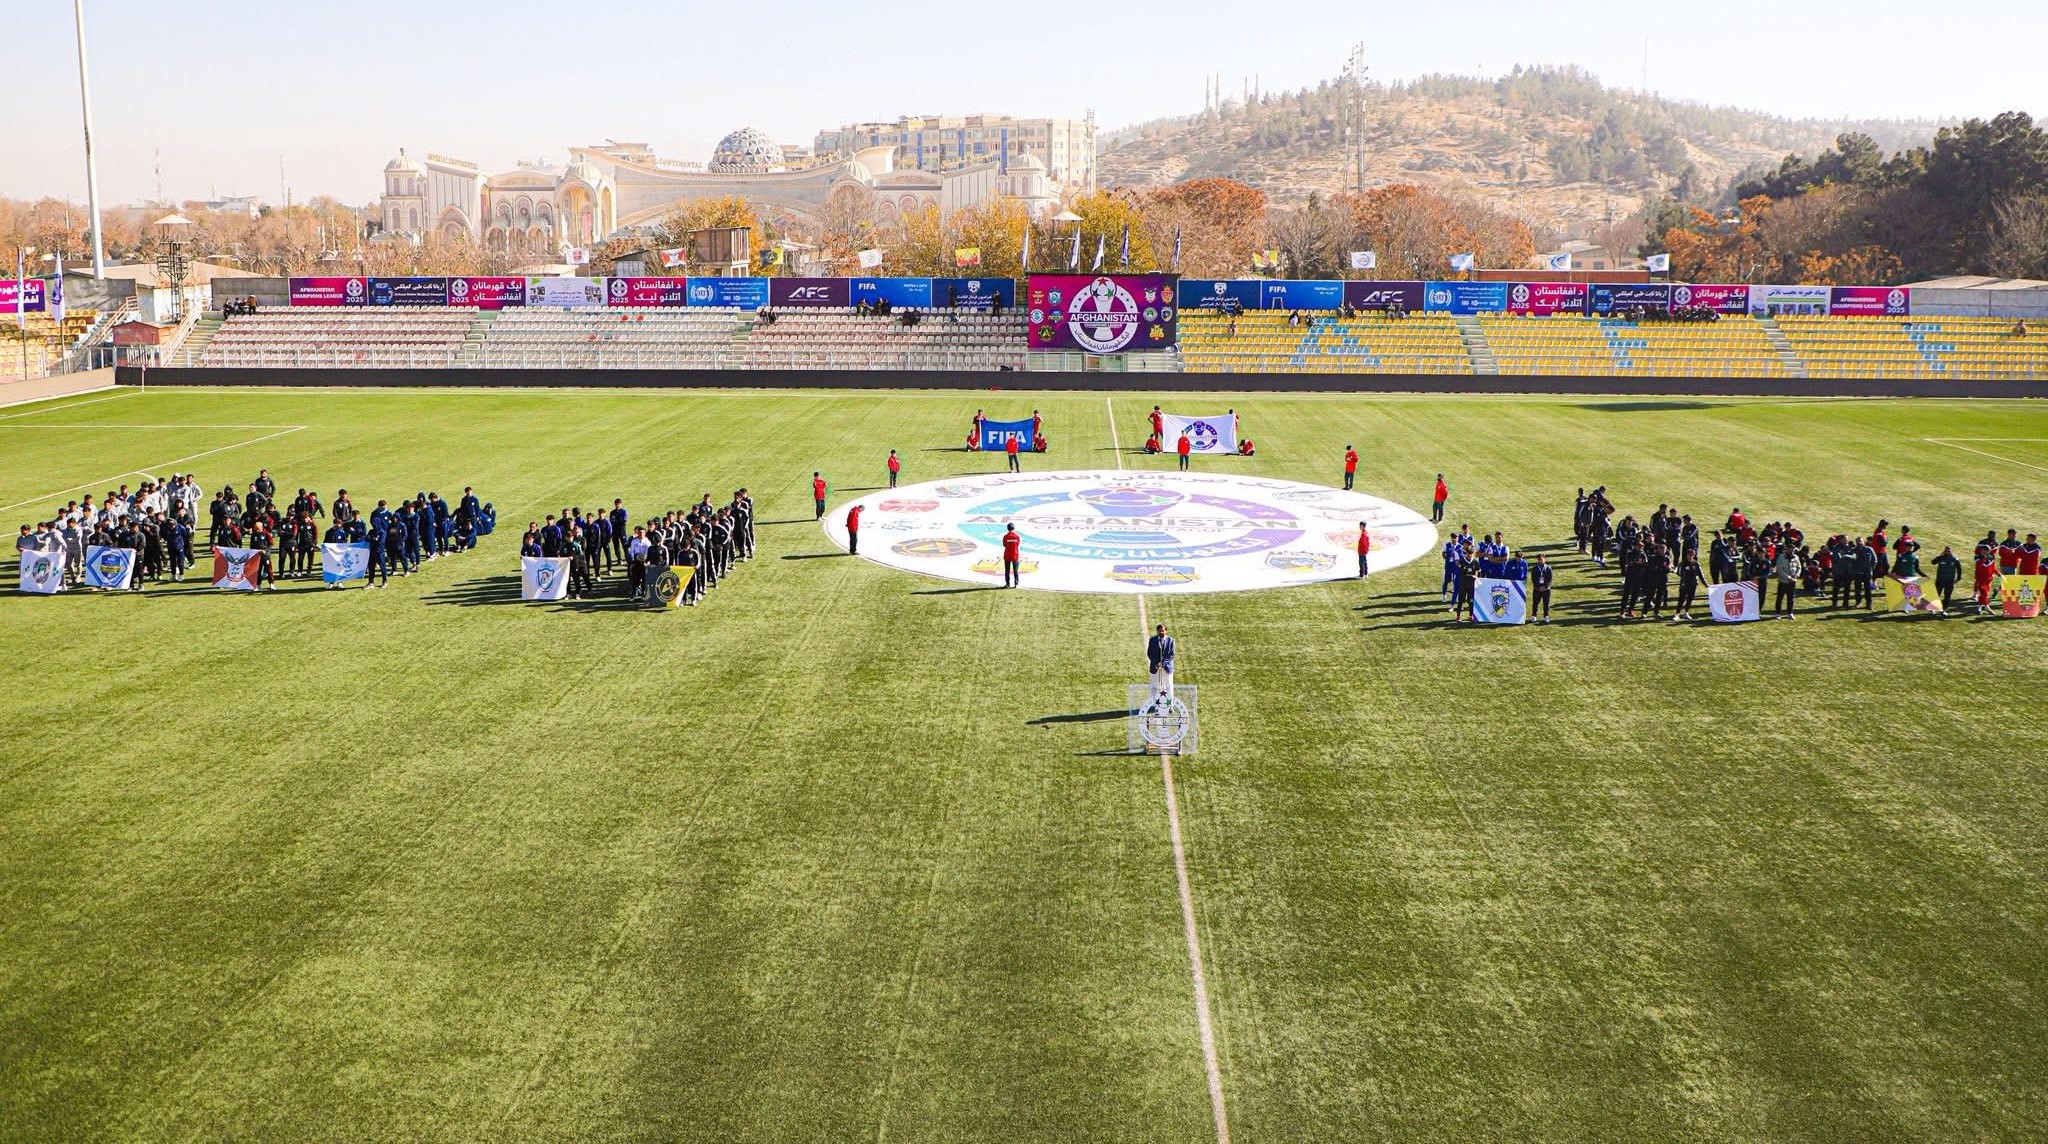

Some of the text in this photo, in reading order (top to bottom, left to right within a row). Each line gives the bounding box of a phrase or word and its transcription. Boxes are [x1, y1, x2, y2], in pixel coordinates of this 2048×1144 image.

[472, 281, 522, 291] لیگ قهرمانان
[633, 280, 674, 291] افغانستان
[858, 283, 876, 291] FIFA
[1535, 285, 1577, 296] افغانستان
[788, 286, 831, 298] AFC
[1363, 291, 1406, 302] AFC
[1695, 289, 1746, 299] لیگ قهرمانان
[1069, 313, 1138, 322] AFGHANISTAN
[965, 515, 1298, 529] AFGHANISTAN
